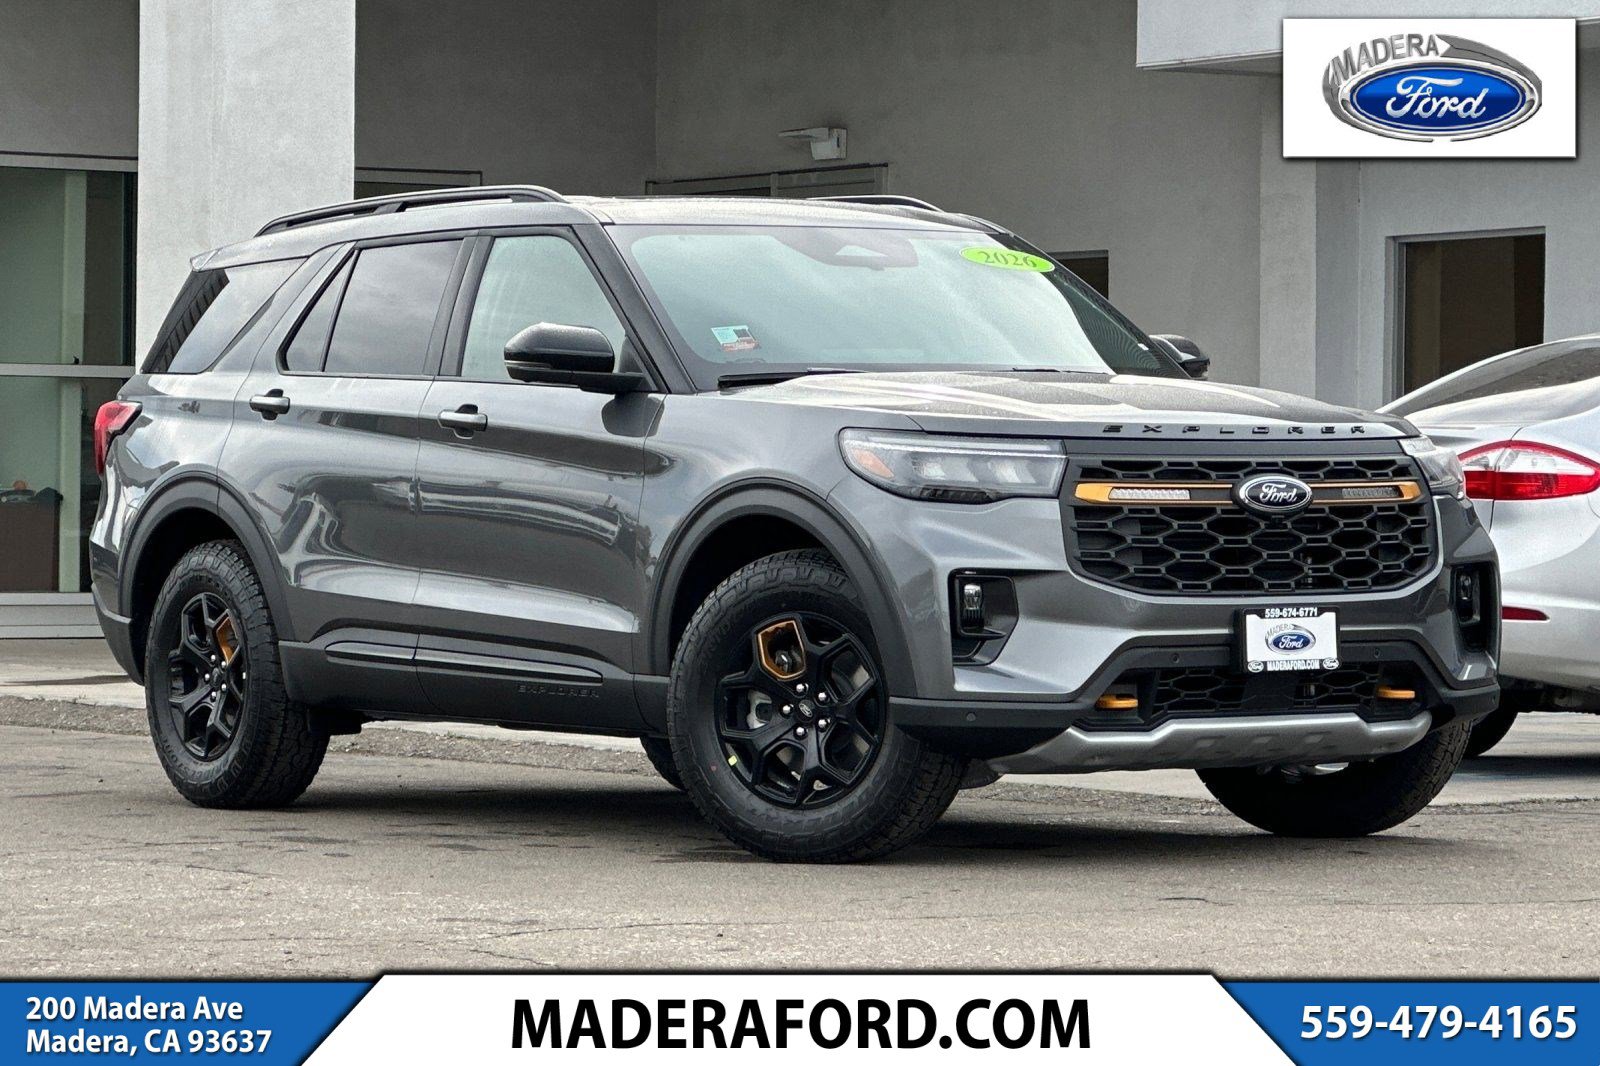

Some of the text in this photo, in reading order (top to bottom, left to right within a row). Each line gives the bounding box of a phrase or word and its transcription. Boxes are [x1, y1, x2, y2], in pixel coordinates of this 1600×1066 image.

[977, 250, 1038, 268] 2026
[1102, 424, 1366, 435] EXPLORER
[1259, 482, 1298, 504] Ford
[1264, 606, 1318, 618] 559-674-6771
[1278, 635, 1304, 649] Ford
[1266, 659, 1321, 672] MADERAFORD.COM
